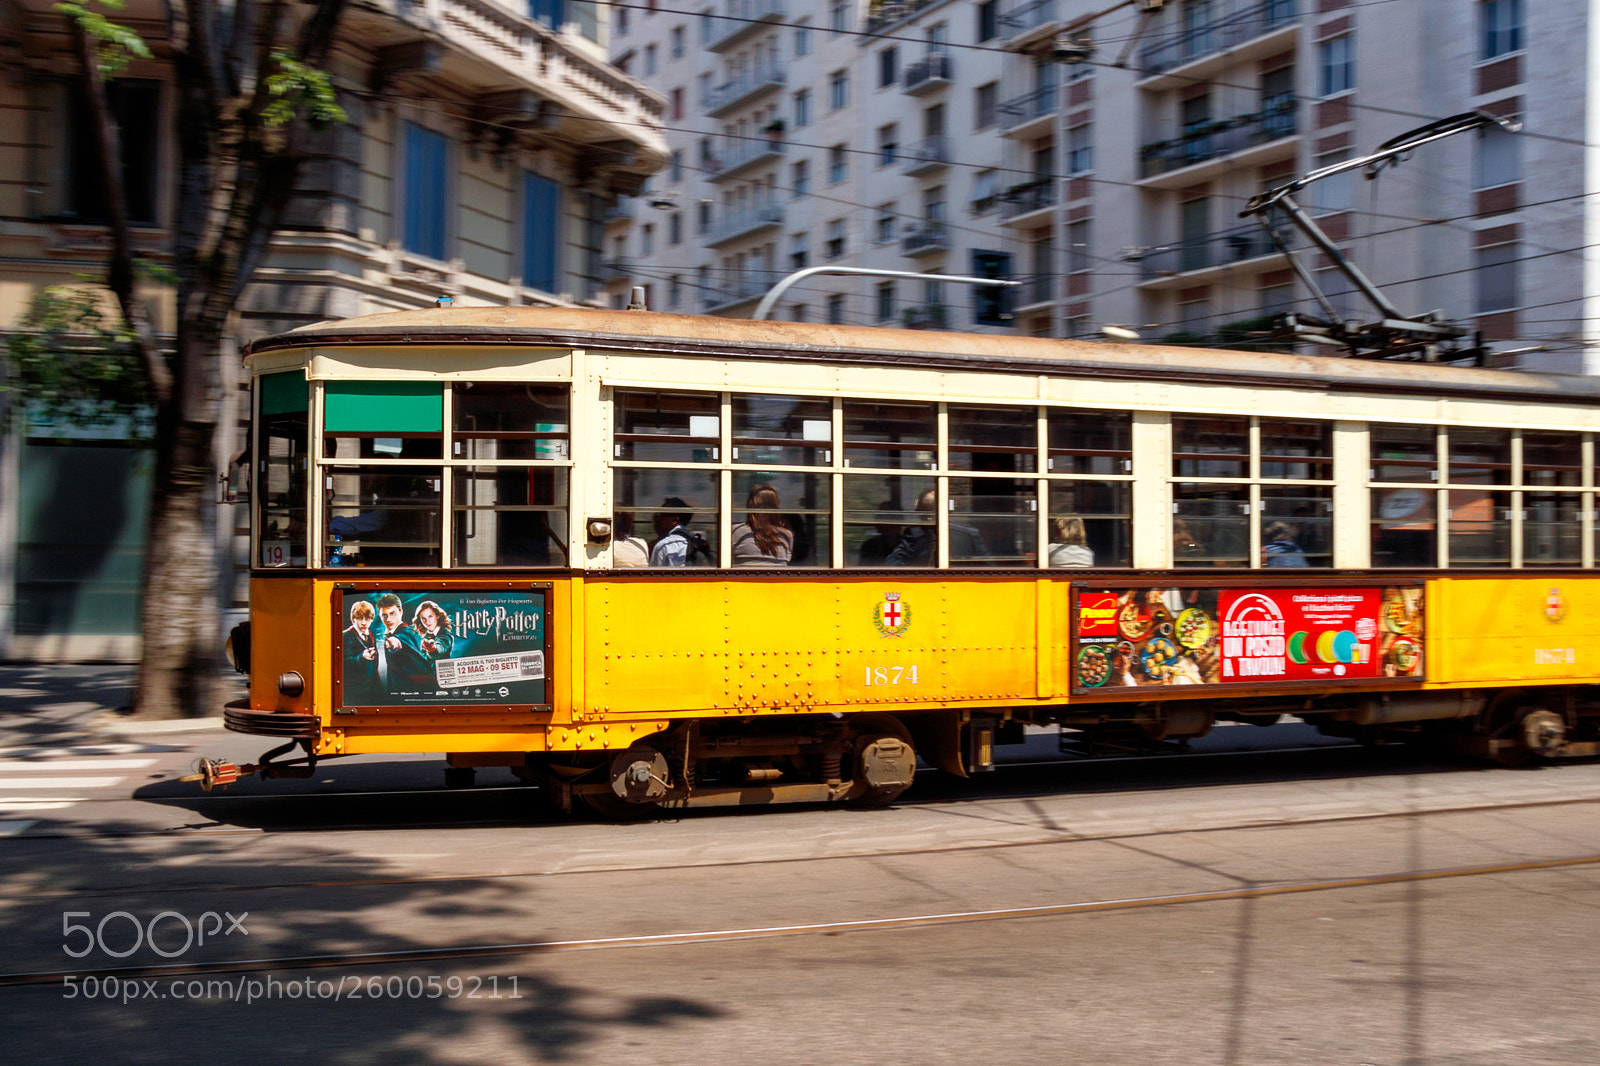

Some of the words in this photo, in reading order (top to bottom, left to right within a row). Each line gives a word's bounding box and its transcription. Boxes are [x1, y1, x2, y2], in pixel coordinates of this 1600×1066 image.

[266, 546, 283, 564] 19
[453, 609, 496, 639] Harry
[494, 606, 540, 644] Potter
[467, 665, 485, 673] MAG
[501, 661, 519, 670] SETT
[864, 664, 920, 687] 1874
